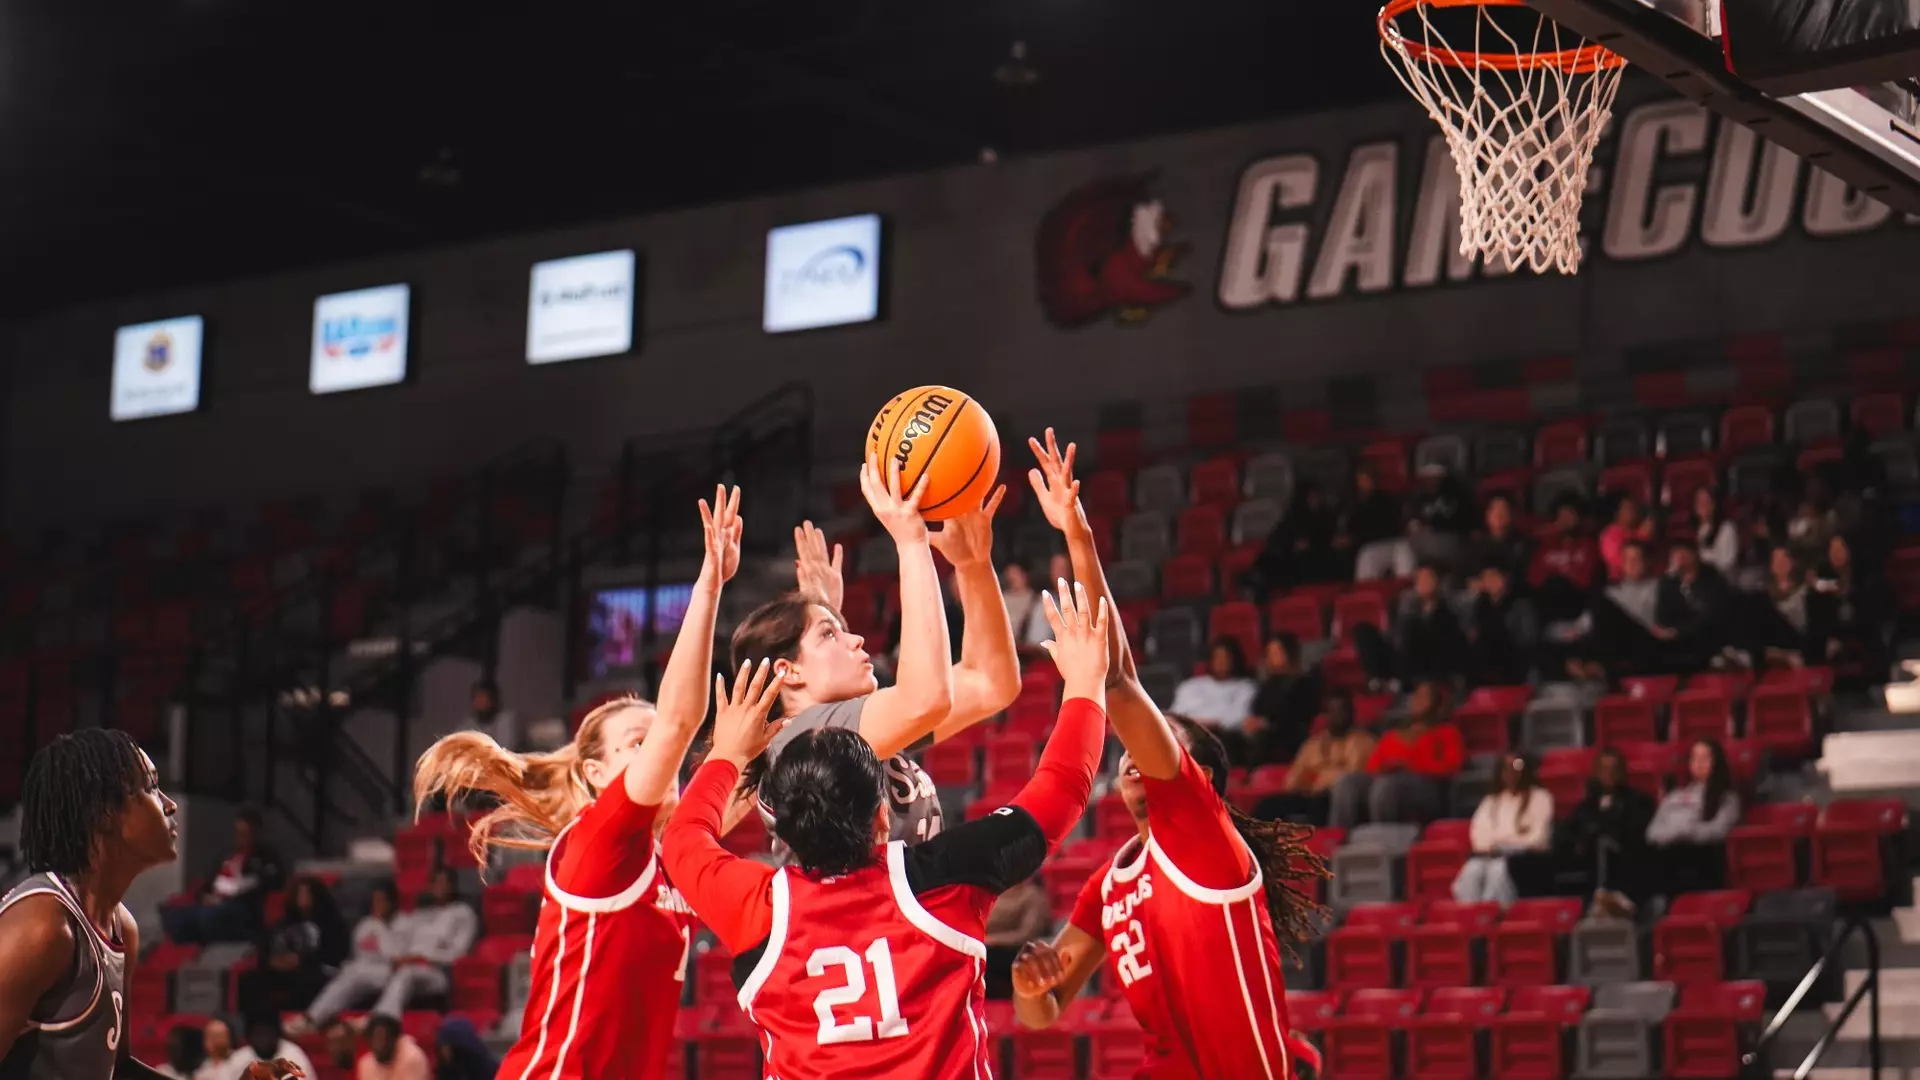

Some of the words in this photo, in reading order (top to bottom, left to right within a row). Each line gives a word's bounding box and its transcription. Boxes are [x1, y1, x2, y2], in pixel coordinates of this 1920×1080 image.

[895, 394, 953, 471] Wilson
[806, 937, 909, 1045] 21
[1111, 919, 1153, 989] 22
